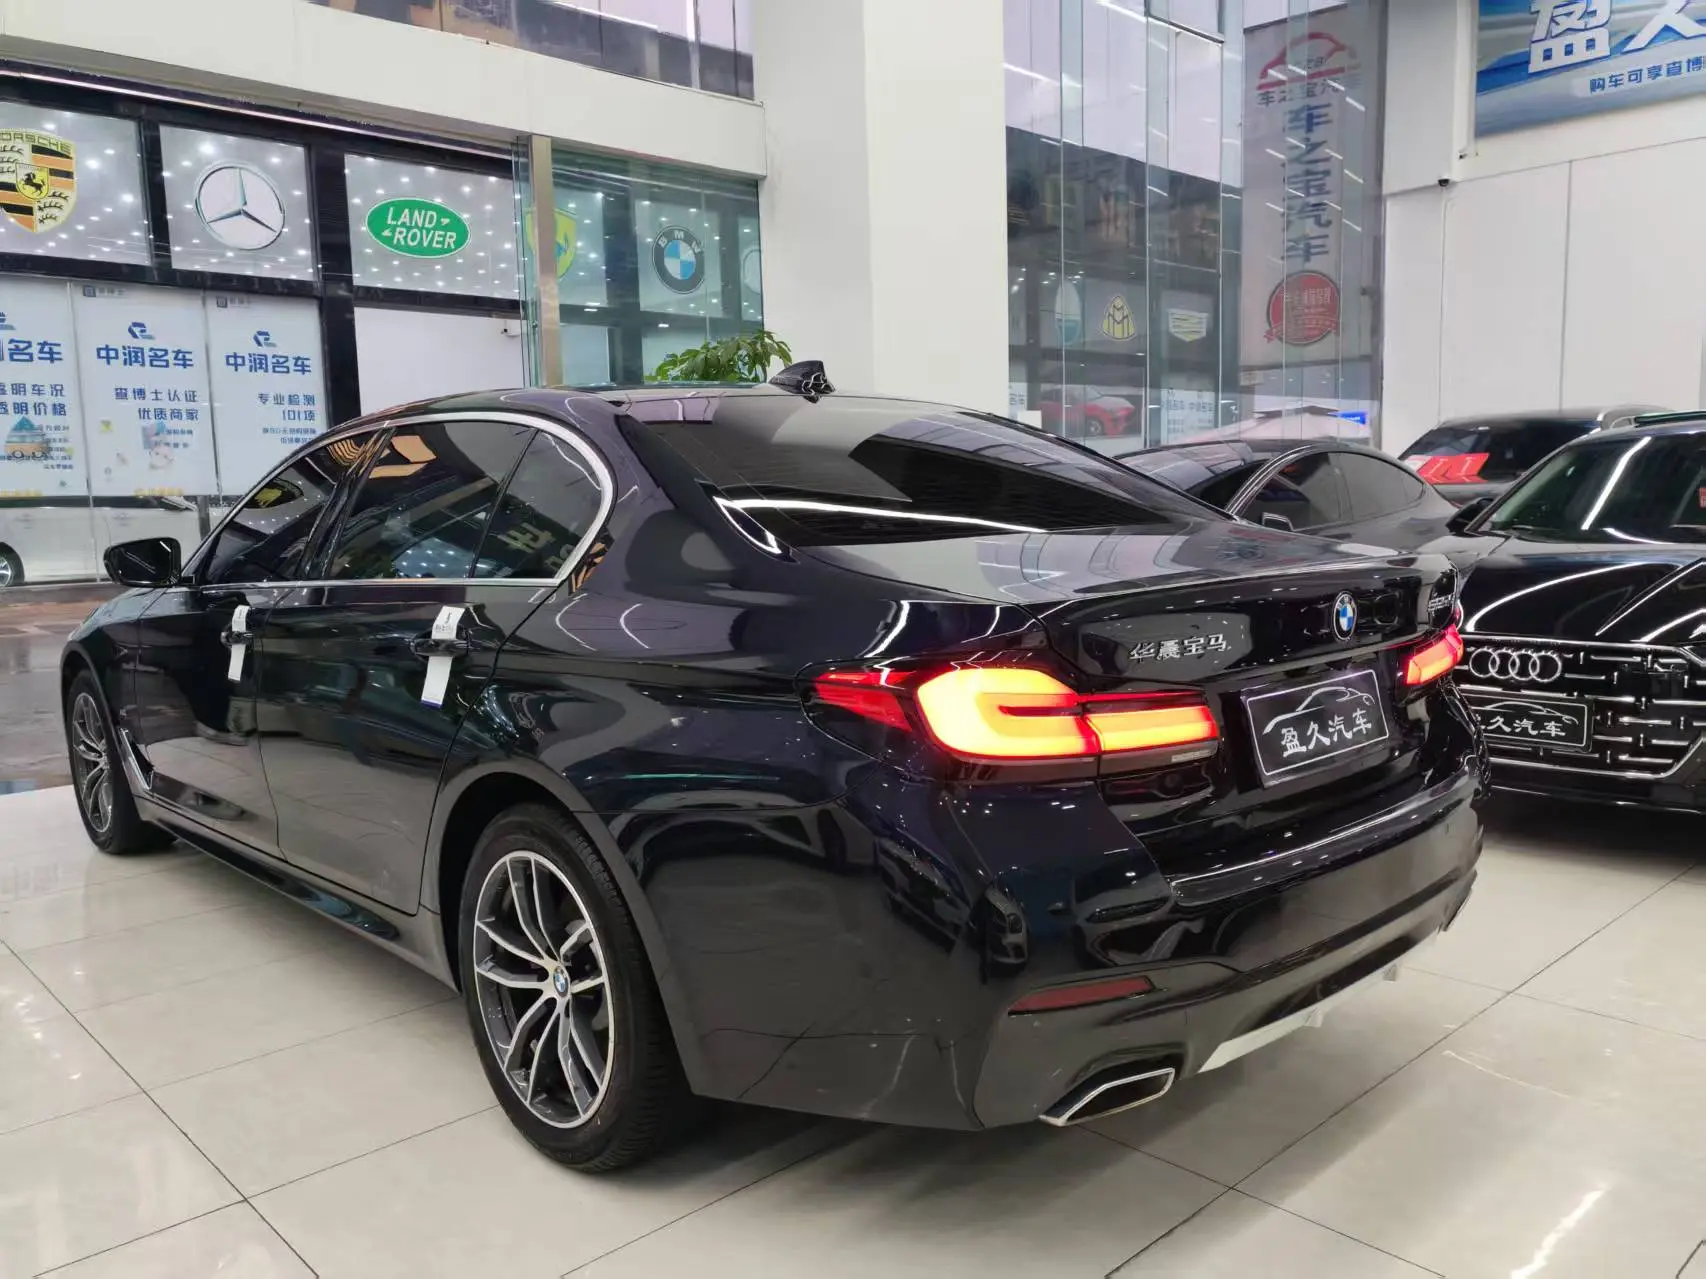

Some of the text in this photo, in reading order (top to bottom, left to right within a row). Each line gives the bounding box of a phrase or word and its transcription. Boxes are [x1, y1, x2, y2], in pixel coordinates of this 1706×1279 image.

[0, 132, 72, 155] ORSCHE
[387, 207, 437, 228] LAND
[393, 227, 457, 249] ROVER
[658, 230, 701, 253] BMW
[0, 338, 63, 364] 名车
[96, 344, 194, 369] 中润名车
[225, 352, 312, 375] 中润名车
[114, 387, 200, 402] 查博士认证
[258, 393, 315, 407] 专业检测
[138, 407, 199, 421] 优质商家
[1129, 633, 1232, 661] 华晨宝马
[1281, 707, 1372, 757] 盈久汽车
[1477, 714, 1566, 737] 久汽车
